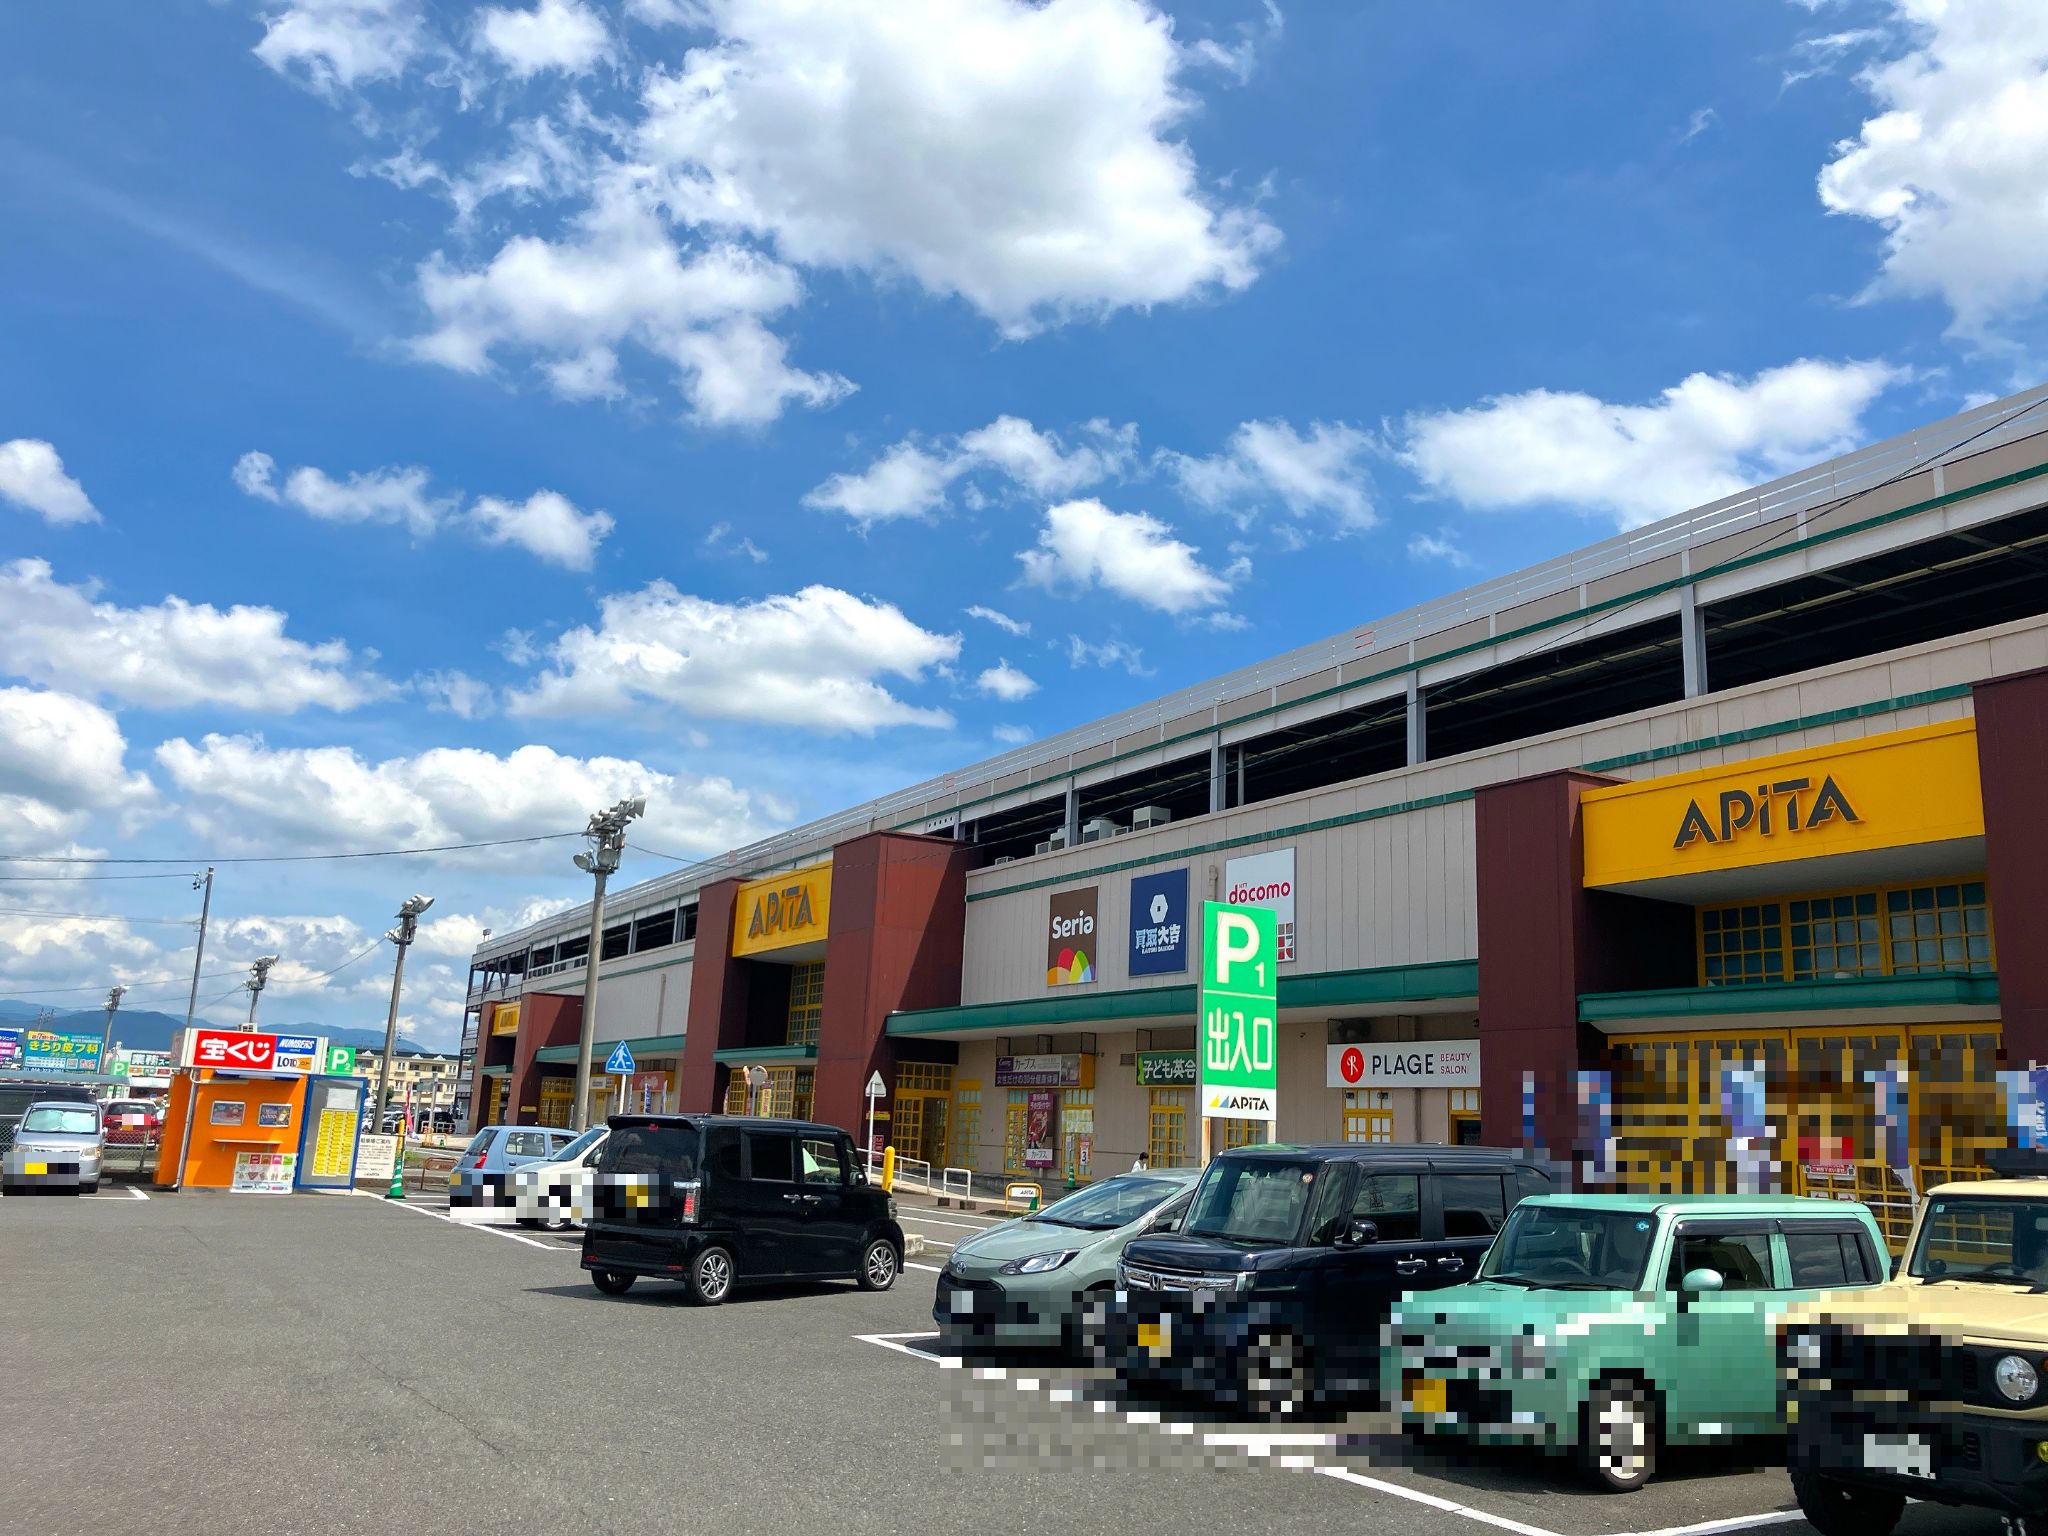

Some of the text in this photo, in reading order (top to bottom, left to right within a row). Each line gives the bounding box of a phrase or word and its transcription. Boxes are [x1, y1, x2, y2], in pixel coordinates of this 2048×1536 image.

[1229, 882, 1291, 904] docomo
[1052, 910, 1094, 939] Seria
[1135, 924, 1181, 950] 買取大吉
[201, 1038, 271, 1062] 宝くじ
[278, 1038, 315, 1049] NUMBERS
[1207, 1007, 1272, 1074] 出入口
[1372, 1054, 1434, 1075] PLAGE
[1440, 1052, 1472, 1062] BEAUTY
[1440, 1065, 1467, 1075] SALON
